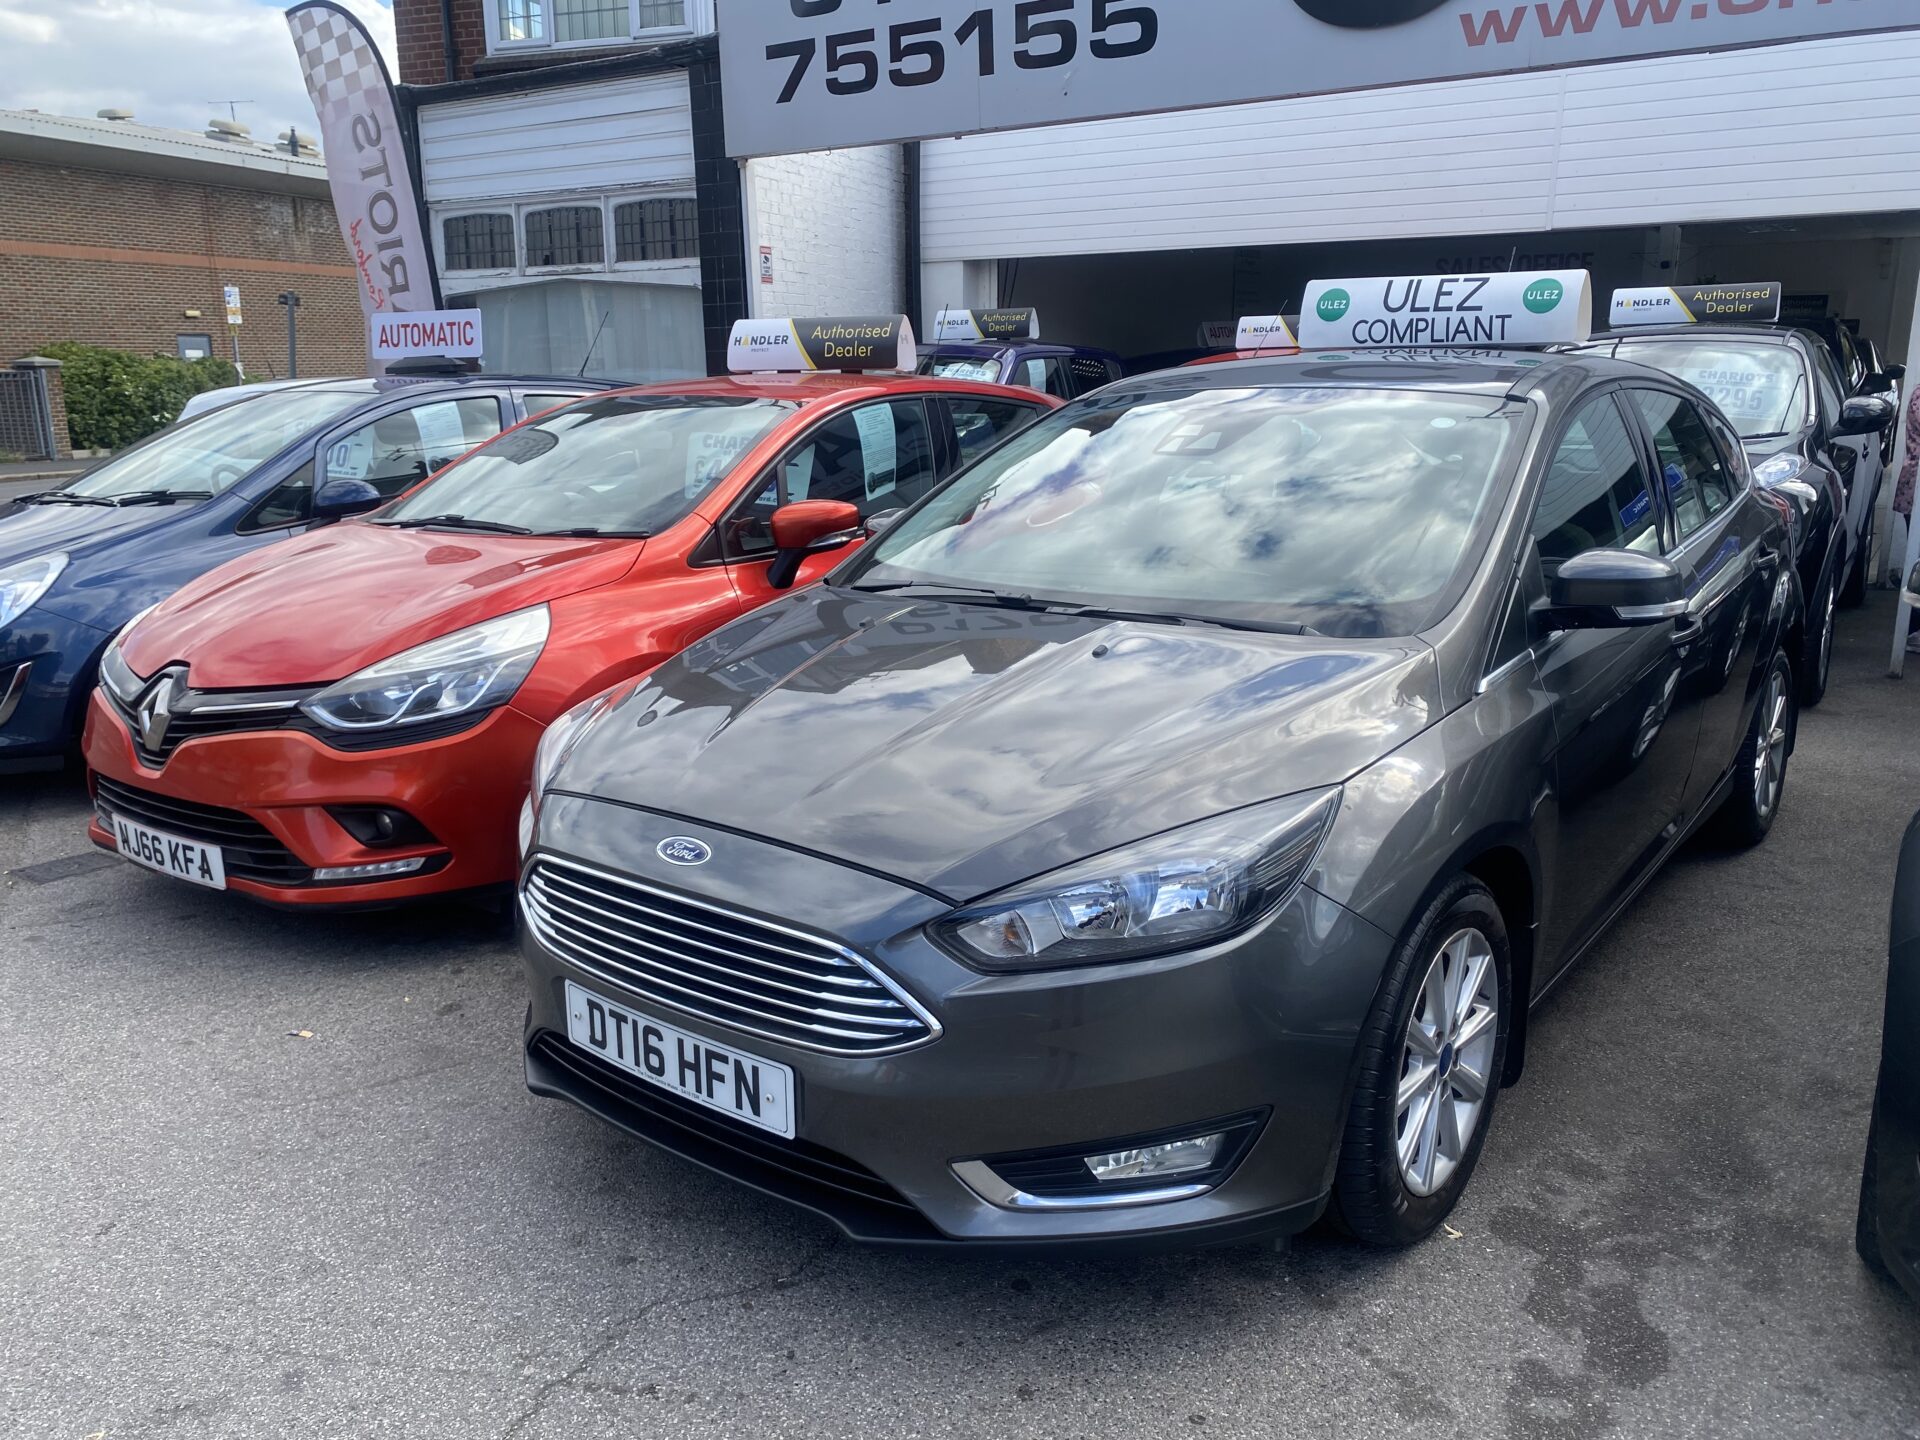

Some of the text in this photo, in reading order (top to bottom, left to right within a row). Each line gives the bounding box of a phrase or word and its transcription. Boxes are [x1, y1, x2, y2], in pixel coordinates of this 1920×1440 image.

[1459, 0, 1832, 47] www.
[765, 0, 1158, 104] 755155
[1383, 277, 1491, 312] ULEZ
[1527, 289, 1560, 300] ULEZ
[1694, 287, 1770, 301] Authorised
[1319, 299, 1347, 309] ULEZ
[1616, 298, 1671, 308] HANDLER
[1706, 301, 1754, 313] Dealer
[982, 312, 1027, 322] Authorised
[379, 320, 474, 348] AUTOMATIC
[811, 322, 892, 339] Authorised
[988, 322, 1017, 332] Dealer
[1240, 325, 1281, 334] HANDLER
[1352, 314, 1512, 344] COMPLIANT
[734, 335, 789, 347] HANDLER
[824, 341, 874, 358] Dealer
[118, 821, 214, 881] NJ66 KFA
[666, 840, 700, 860] Ford
[586, 997, 762, 1118] DT16 HFN
